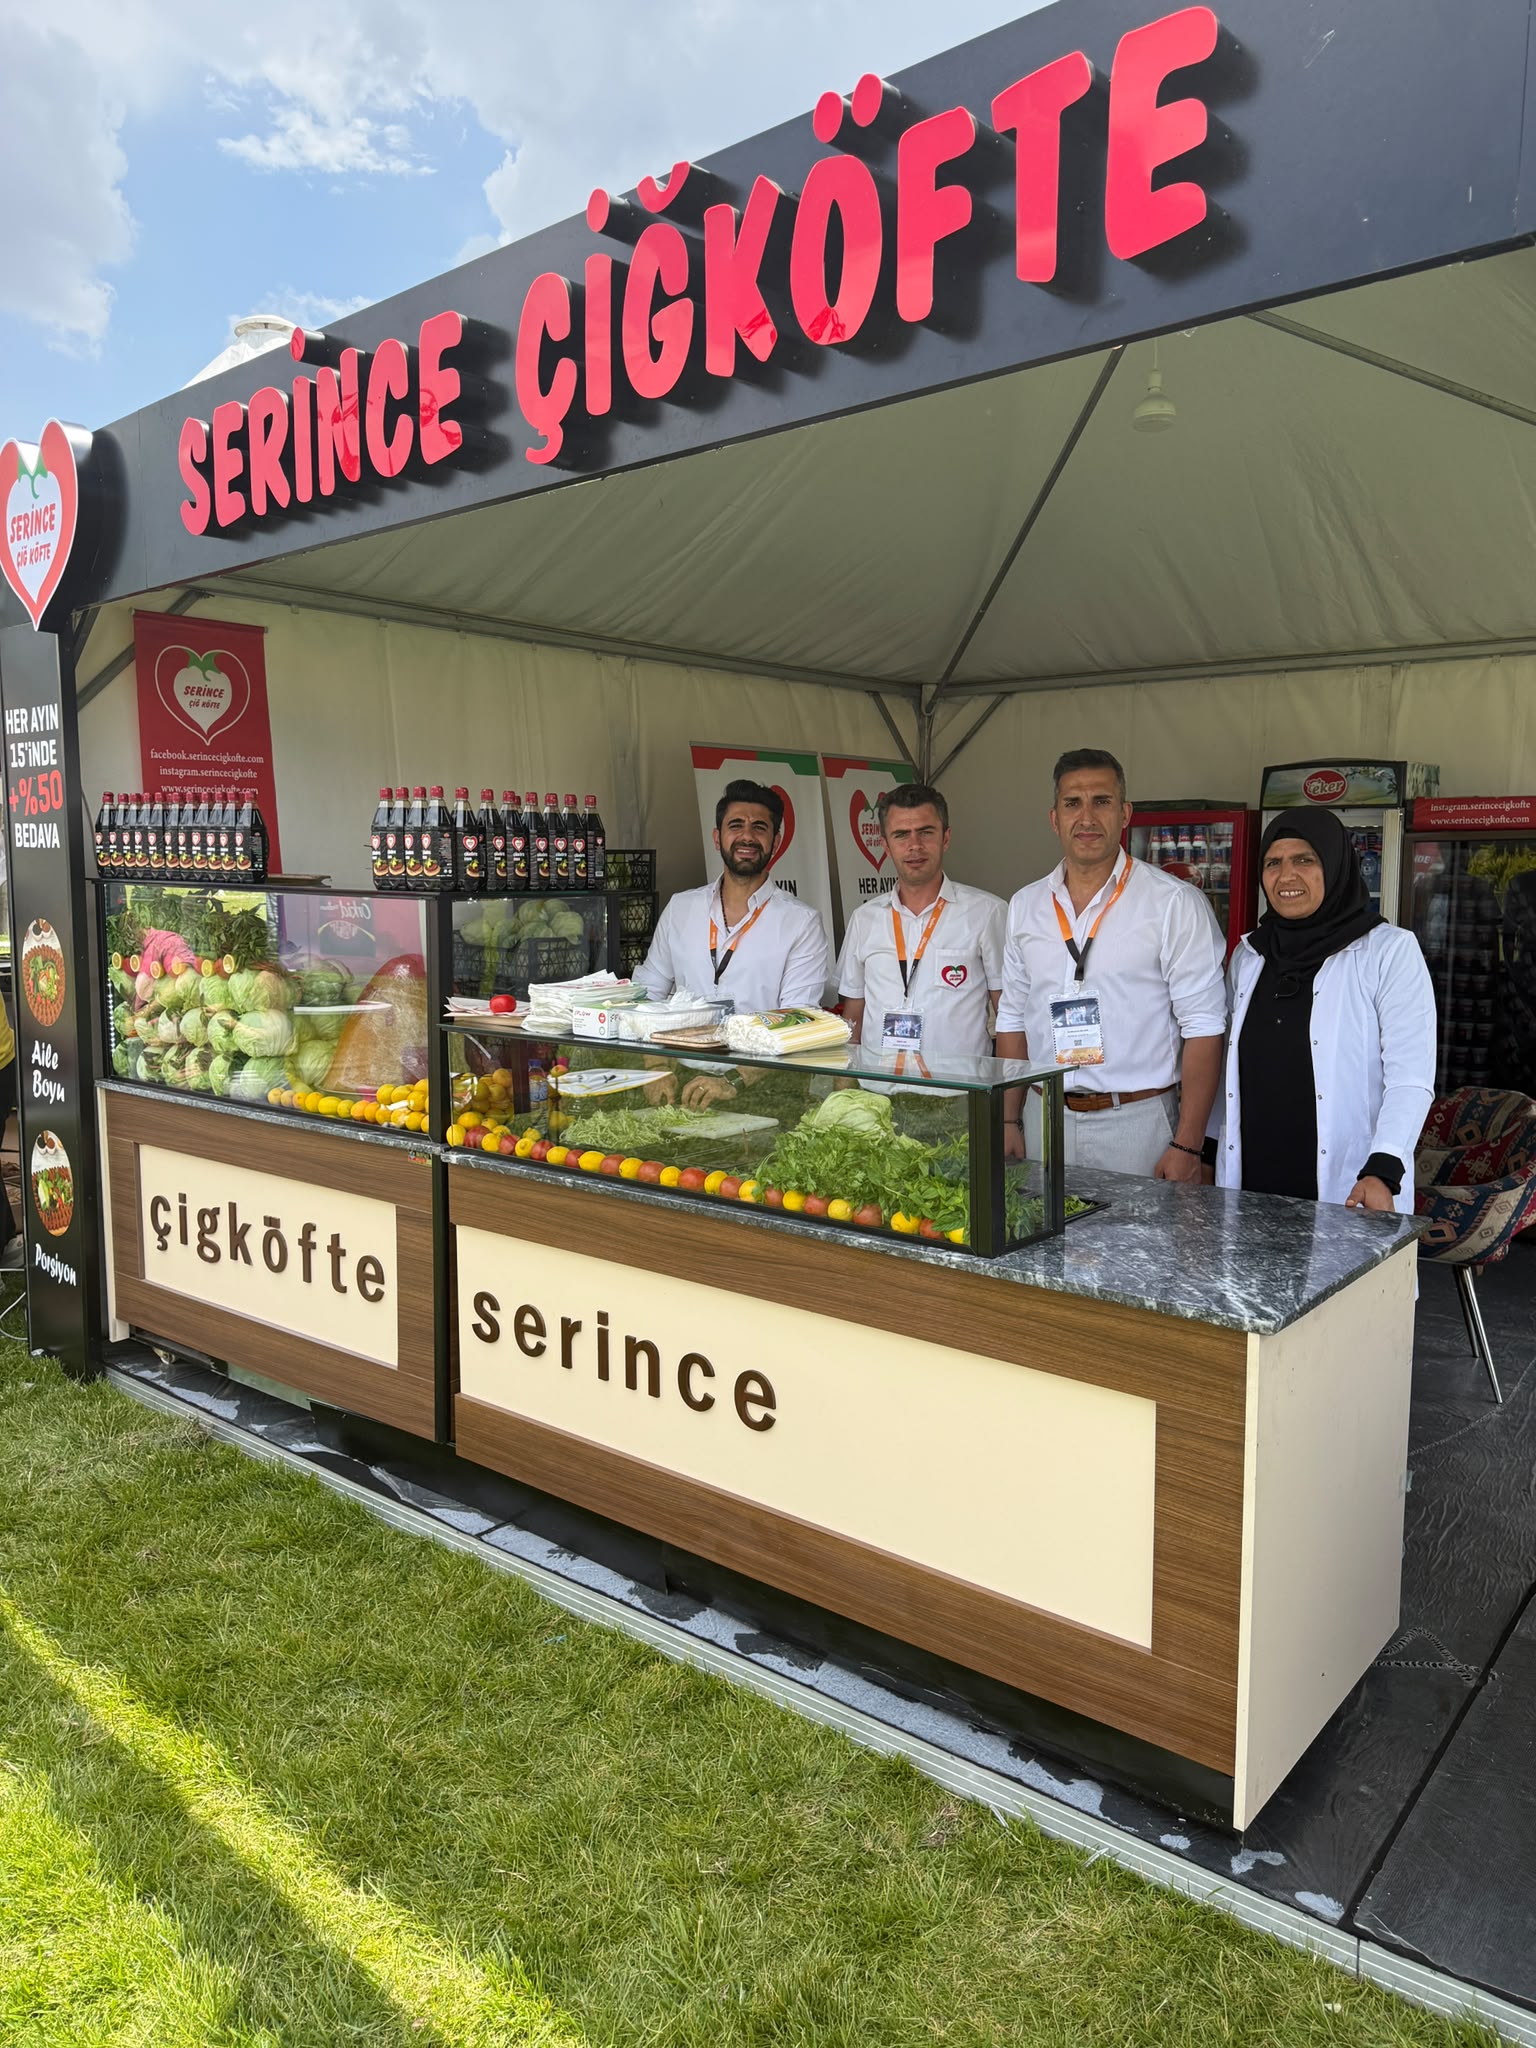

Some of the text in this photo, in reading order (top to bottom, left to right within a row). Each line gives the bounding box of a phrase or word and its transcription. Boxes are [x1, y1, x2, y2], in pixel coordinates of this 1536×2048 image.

[179, 310, 463, 536] SERİNCE
[9, 503, 56, 544] SERİNCE
[29, 541, 51, 566] KÖFTE
[183, 684, 225, 699] SERİNCE
[5, 703, 59, 735] HER AYIN
[150, 748, 264, 765] facebook.serincecigkofte.com
[159, 766, 258, 781] instagram.serincecigkofte
[1430, 799, 1531, 814] instagram.serincecigkofte
[861, 821, 881, 836] SERİN
[1430, 814, 1530, 826] www.serincecigkofte.com
[14, 822, 61, 849] BEDAVA
[775, 879, 798, 897] YIN
[858, 877, 878, 895] HER
[31, 1039, 59, 1070] Aile
[150, 1192, 386, 1303] çigköfte
[35, 1242, 77, 1287] Porsiyon
[471, 1290, 777, 1432] serince
